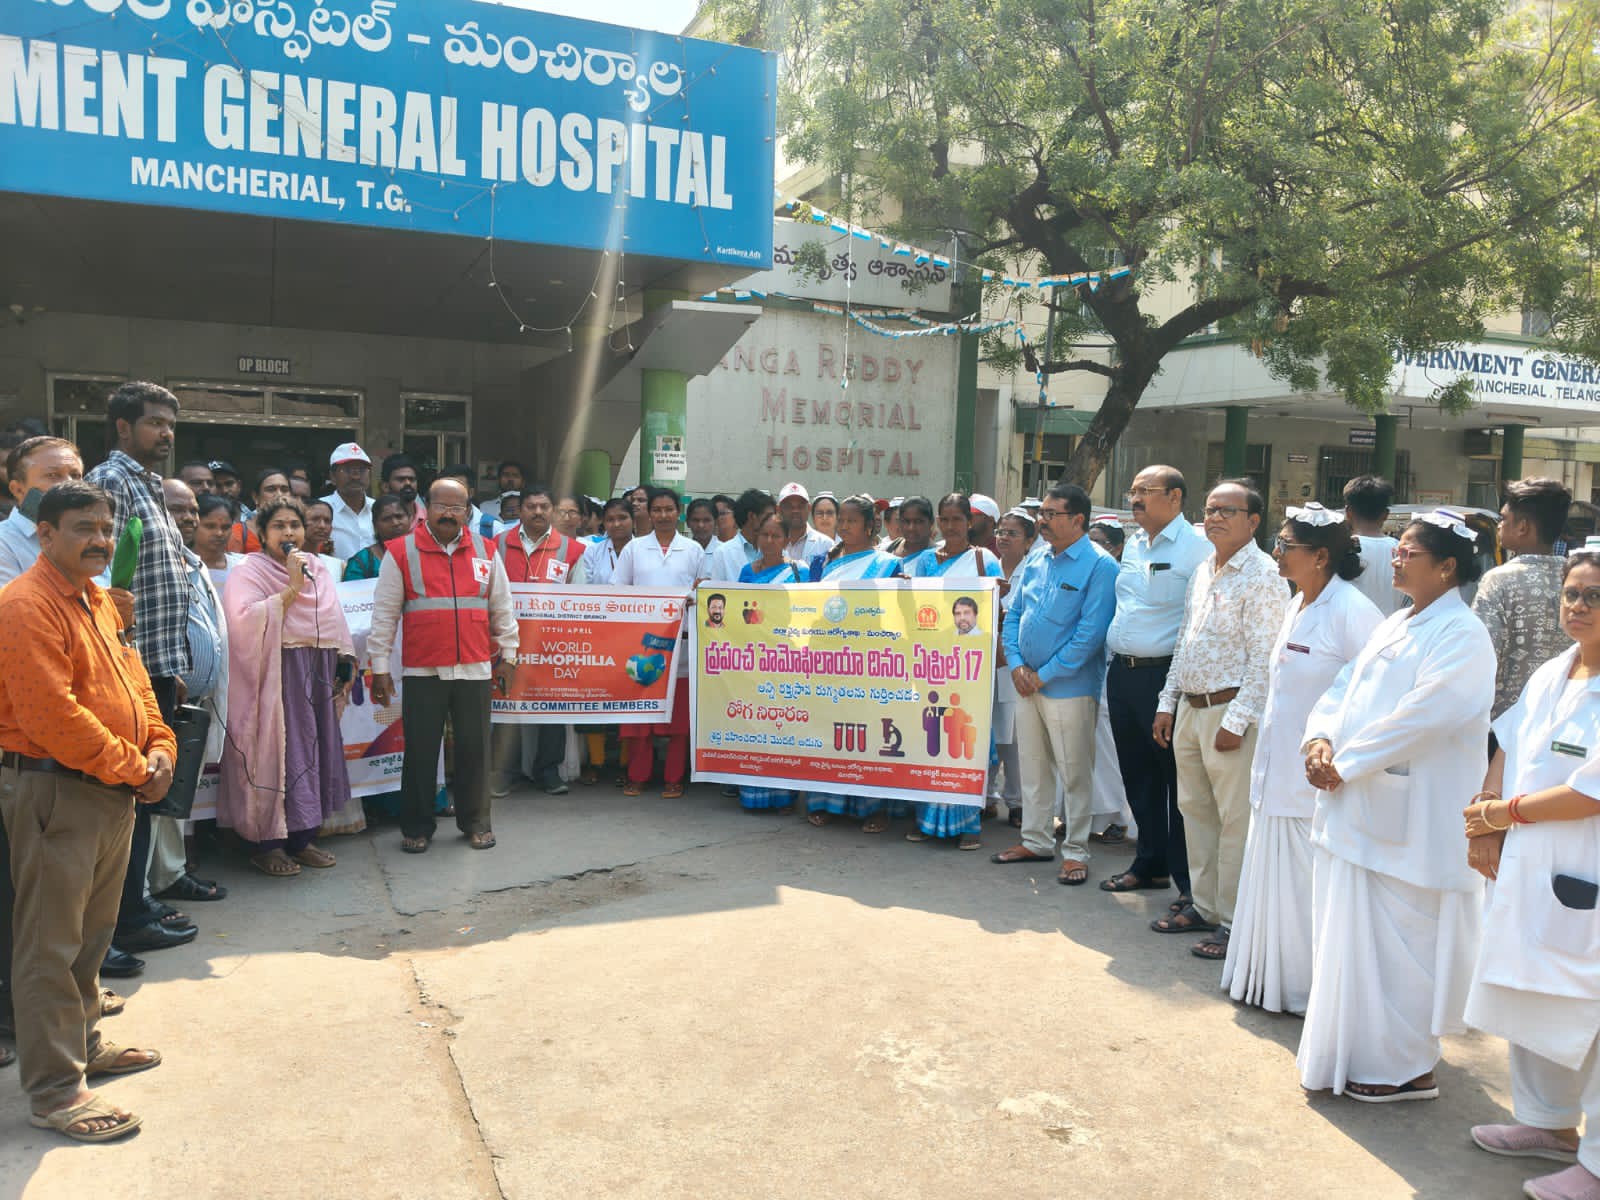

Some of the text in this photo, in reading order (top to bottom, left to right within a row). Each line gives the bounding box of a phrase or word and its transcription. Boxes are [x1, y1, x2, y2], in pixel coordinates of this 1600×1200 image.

[443, 21, 683, 113] మంచిర్యాల
[0, 34, 733, 210] MENT GENERAL HOSPITAL
[131, 156, 412, 214] MANCHERIAL, T.G.
[239, 358, 289, 374] OP BLOCK
[818, 343, 924, 384] REDDY
[762, 386, 922, 430] MEMORIAL
[766, 435, 920, 477] HOSPITAL
[527, 598, 555, 611] Red
[560, 599, 601, 612] Cross
[605, 600, 655, 614] Society
[568, 626, 593, 634] APRIL
[542, 640, 593, 654] WORLD
[518, 653, 616, 667] HEMOPHILIA
[705, 641, 755, 675] ప్రపంచ
[964, 650, 983, 681] 17
[553, 667, 581, 679] DAY
[520, 702, 528, 710] &
[531, 701, 599, 711] COMMITTEE
[602, 700, 659, 710] MEMBERS
[727, 699, 754, 720] రోగ
